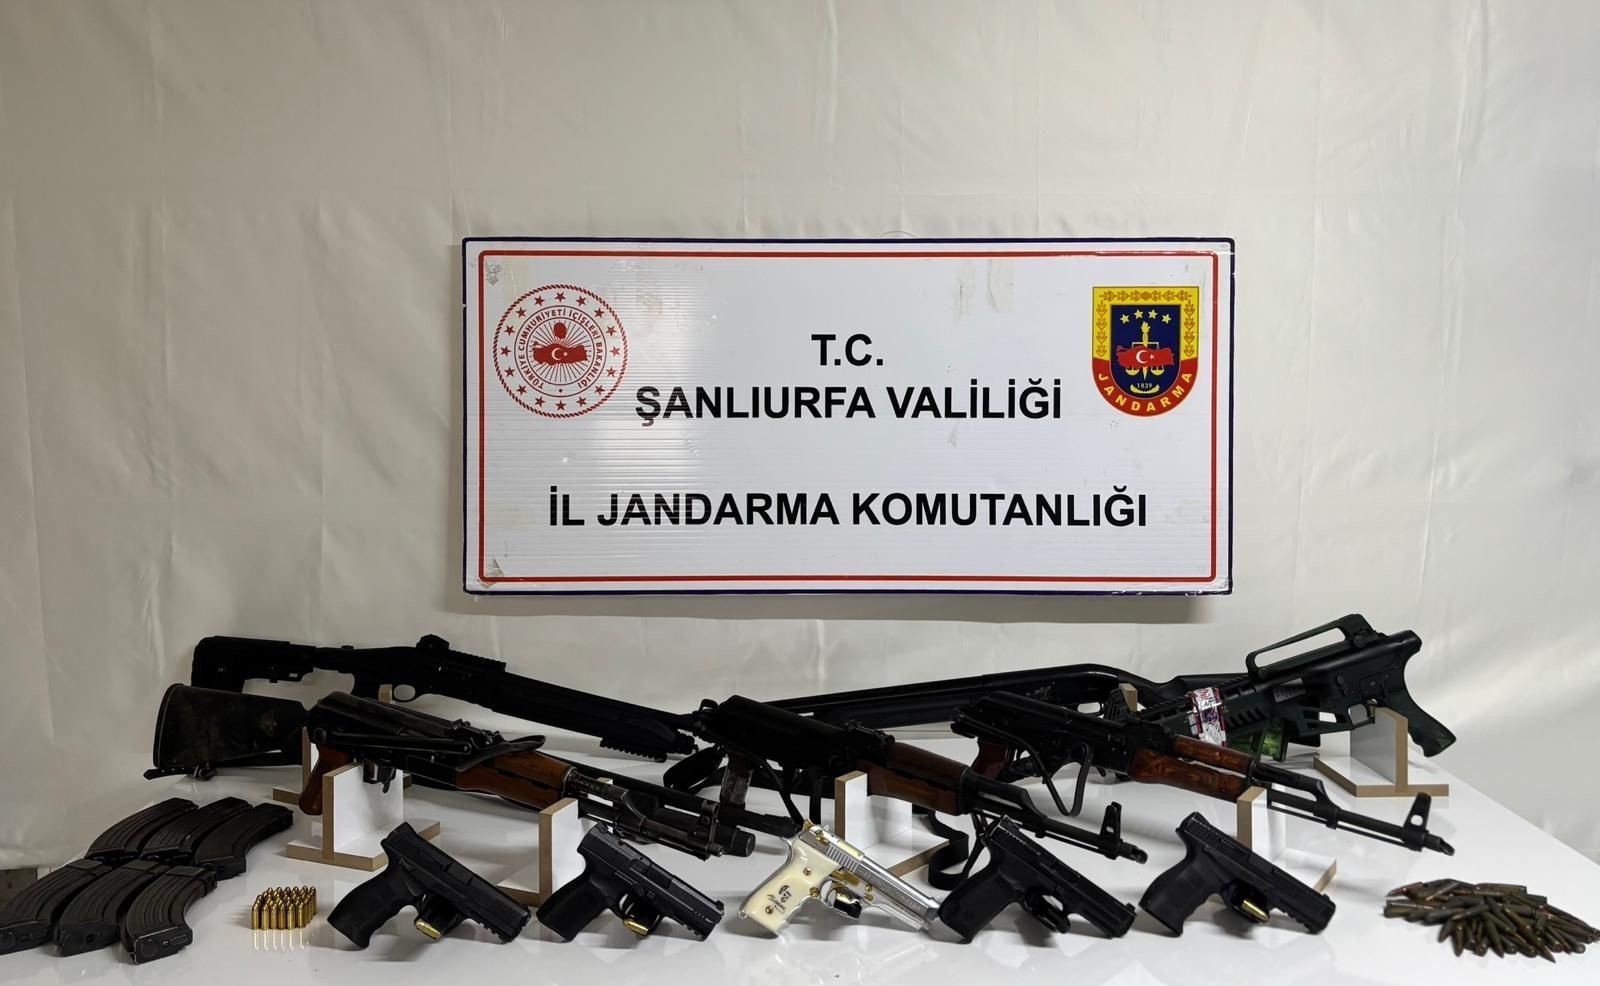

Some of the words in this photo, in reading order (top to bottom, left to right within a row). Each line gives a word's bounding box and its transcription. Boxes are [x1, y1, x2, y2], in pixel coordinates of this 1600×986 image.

[518, 308, 566, 351] CUMHURİYETİ
[568, 309, 601, 340] İÇİŞLERİ
[577, 342, 603, 389] BAKANLIĞI
[811, 334, 884, 367] T.C.
[635, 386, 876, 427] ŞANLIURFA
[886, 378, 1061, 419] VALİLİĞİ
[1098, 372, 1192, 412] JANDARMA
[549, 485, 585, 526] İL
[597, 493, 840, 527] JANDARMA
[852, 485, 1146, 527] KOMUTANLIĞI
